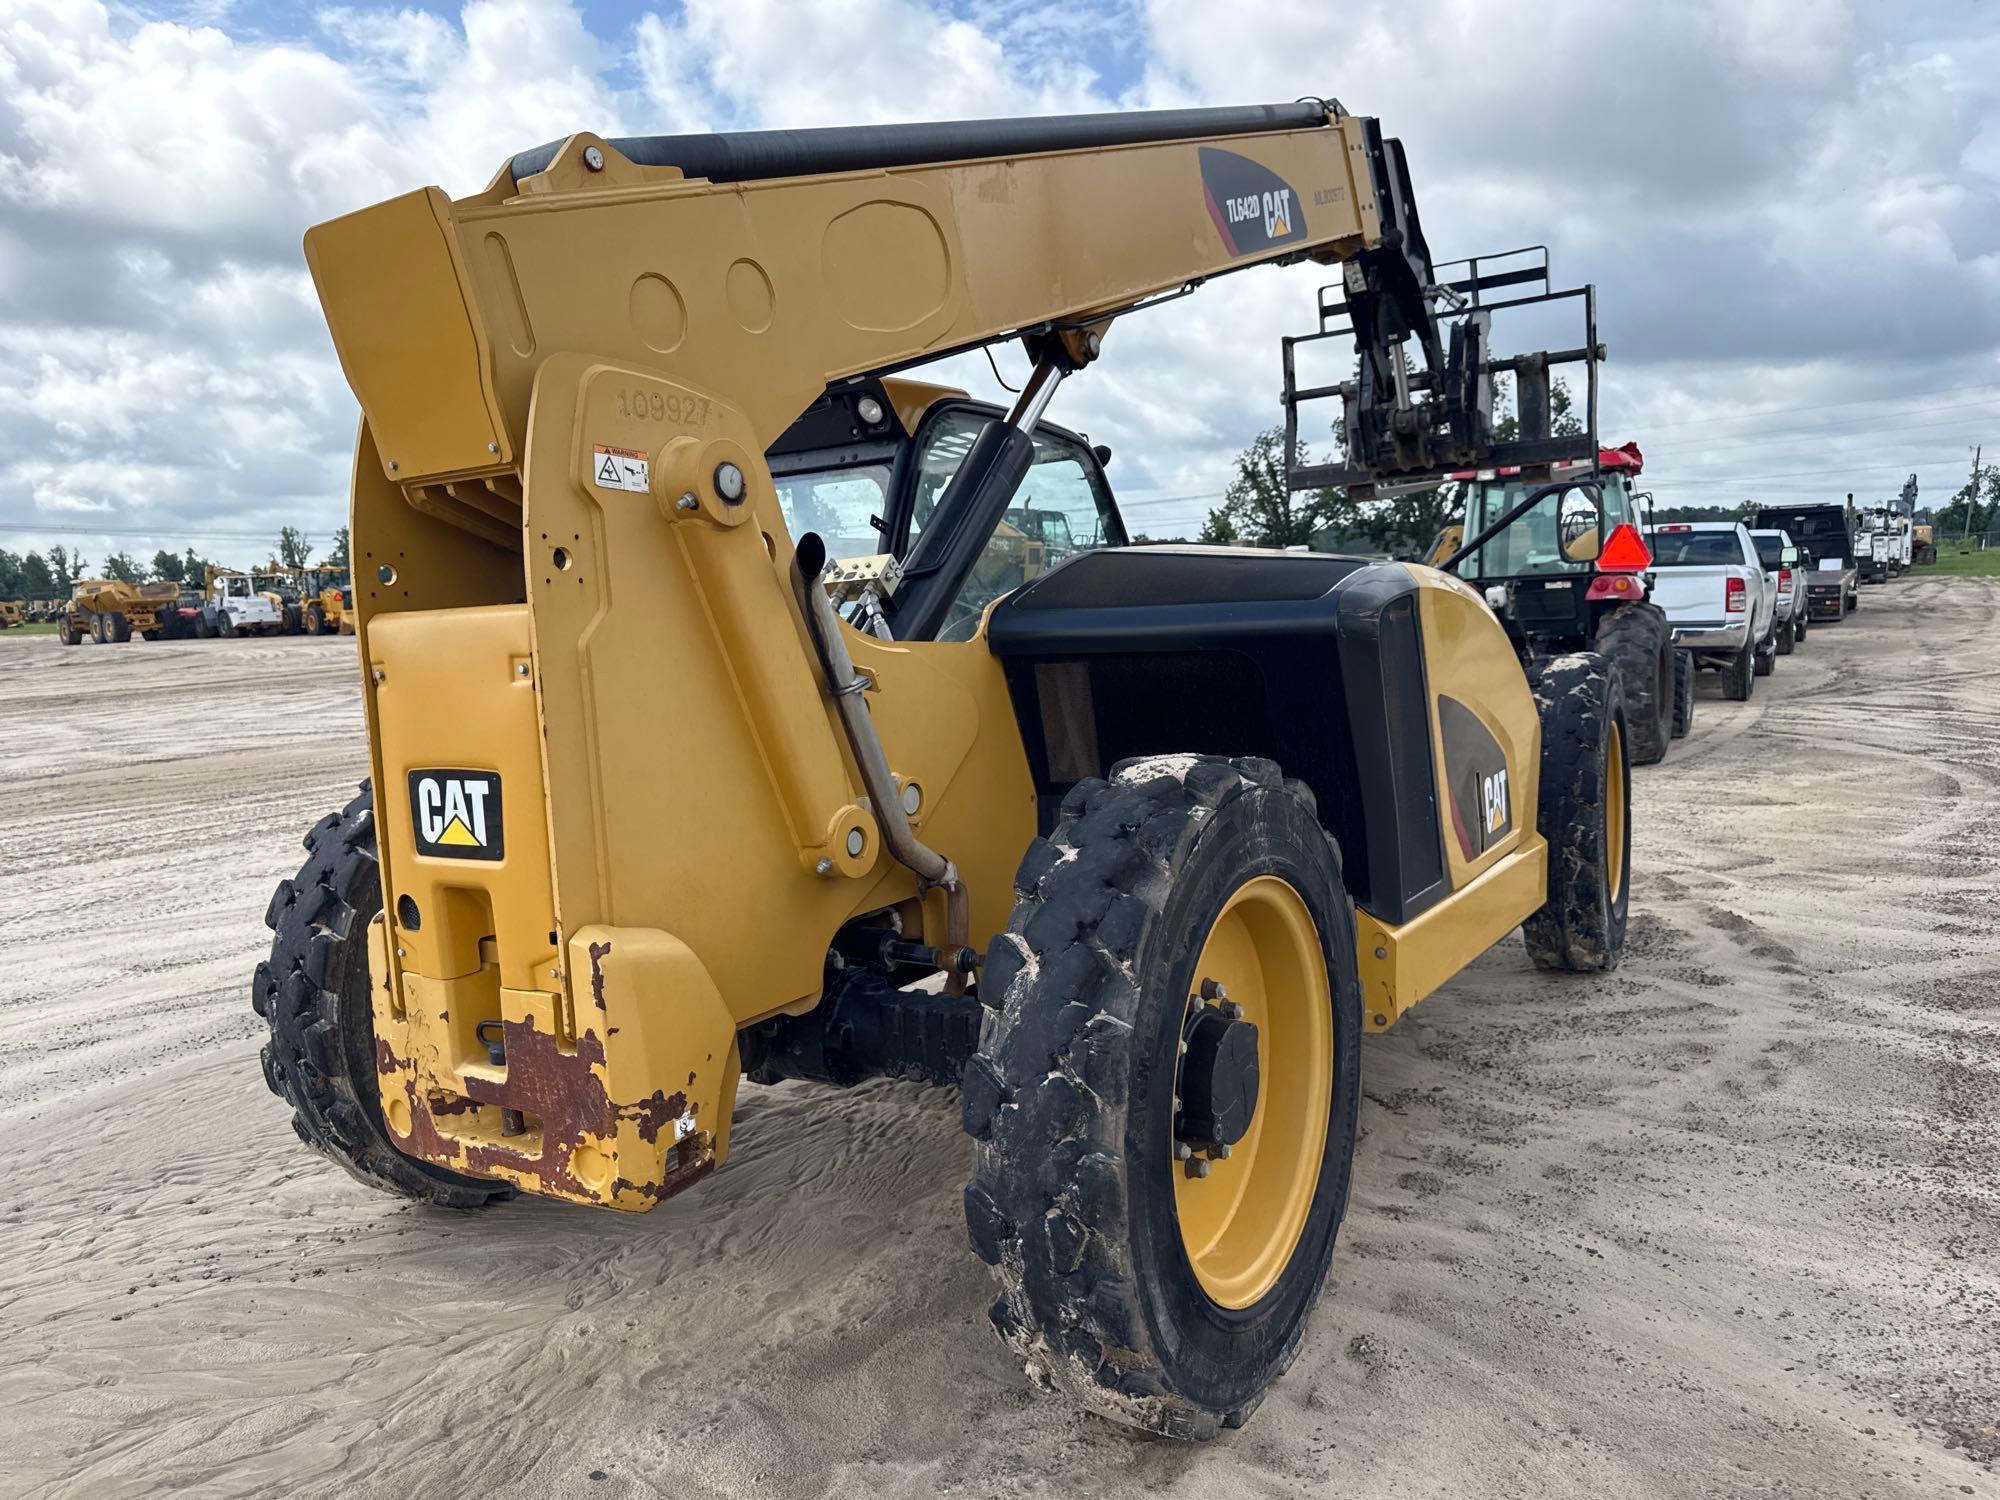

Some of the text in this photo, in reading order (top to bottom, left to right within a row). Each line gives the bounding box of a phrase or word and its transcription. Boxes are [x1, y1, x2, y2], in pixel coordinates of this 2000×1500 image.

[1226, 194, 1260, 223] TL642D
[1262, 189, 1292, 239] CAT
[612, 447, 638, 459] WARNING
[418, 778, 489, 847] CAT
[1484, 769, 1507, 834] CAT
